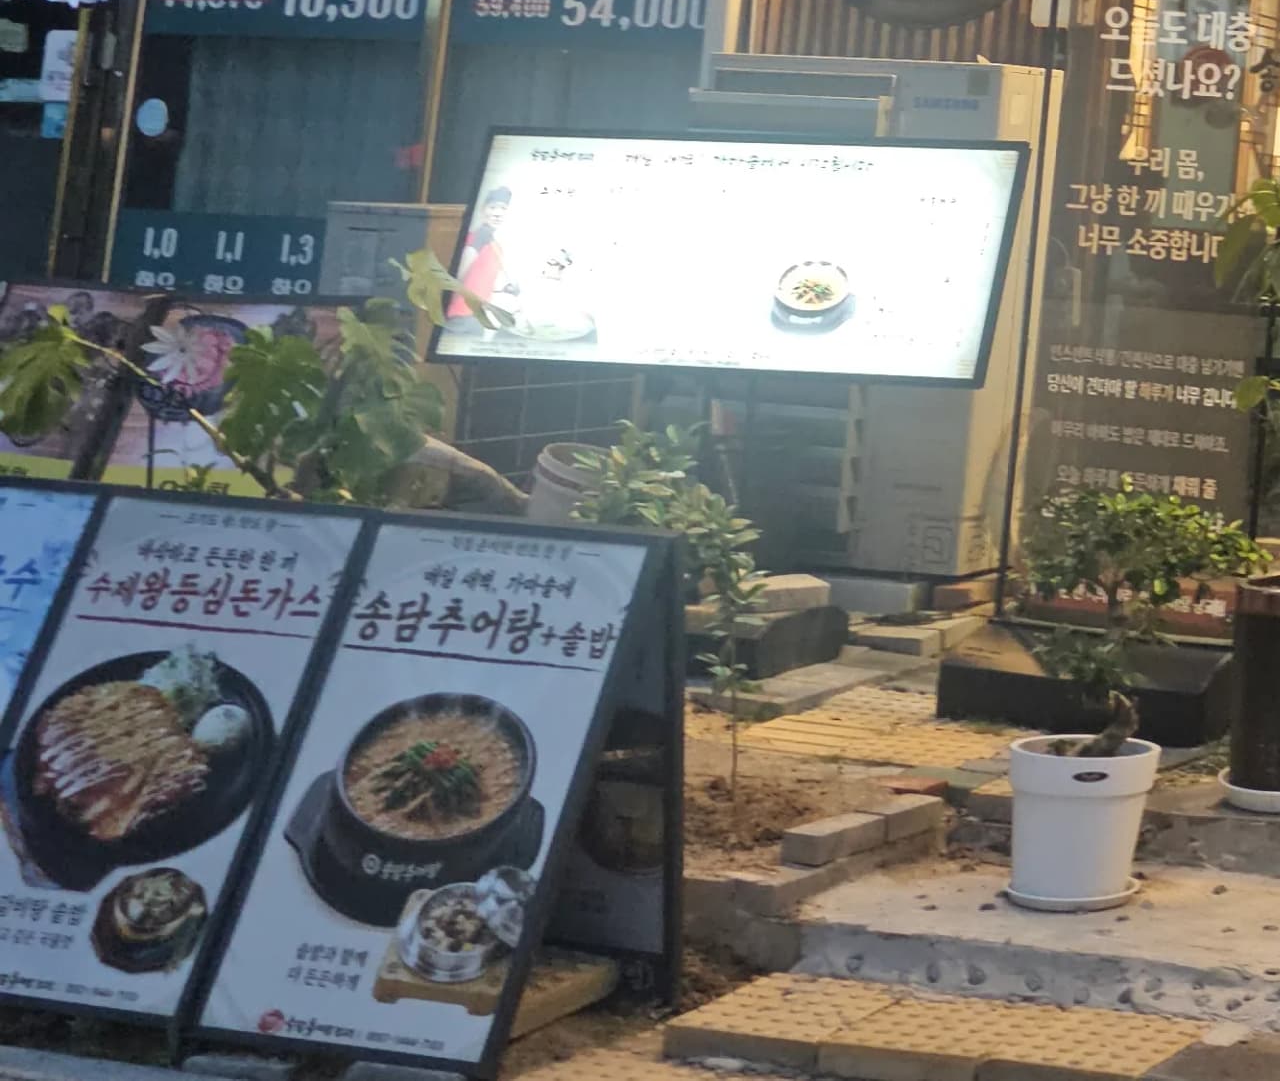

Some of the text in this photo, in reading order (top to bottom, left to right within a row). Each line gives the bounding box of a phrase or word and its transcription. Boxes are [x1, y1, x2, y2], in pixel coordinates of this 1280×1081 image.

[1197, 11, 1252, 53] 대충
[1105, 57, 1242, 101] 드셨나요?
[1127, 145, 1205, 182] 우리 몸,
[1065, 183, 1112, 215] 그냥
[1116, 185, 1140, 217] 한
[1145, 187, 1167, 219] 끼
[1077, 223, 1122, 256] 너무
[86, 567, 321, 620] 수제왕등심돈가스
